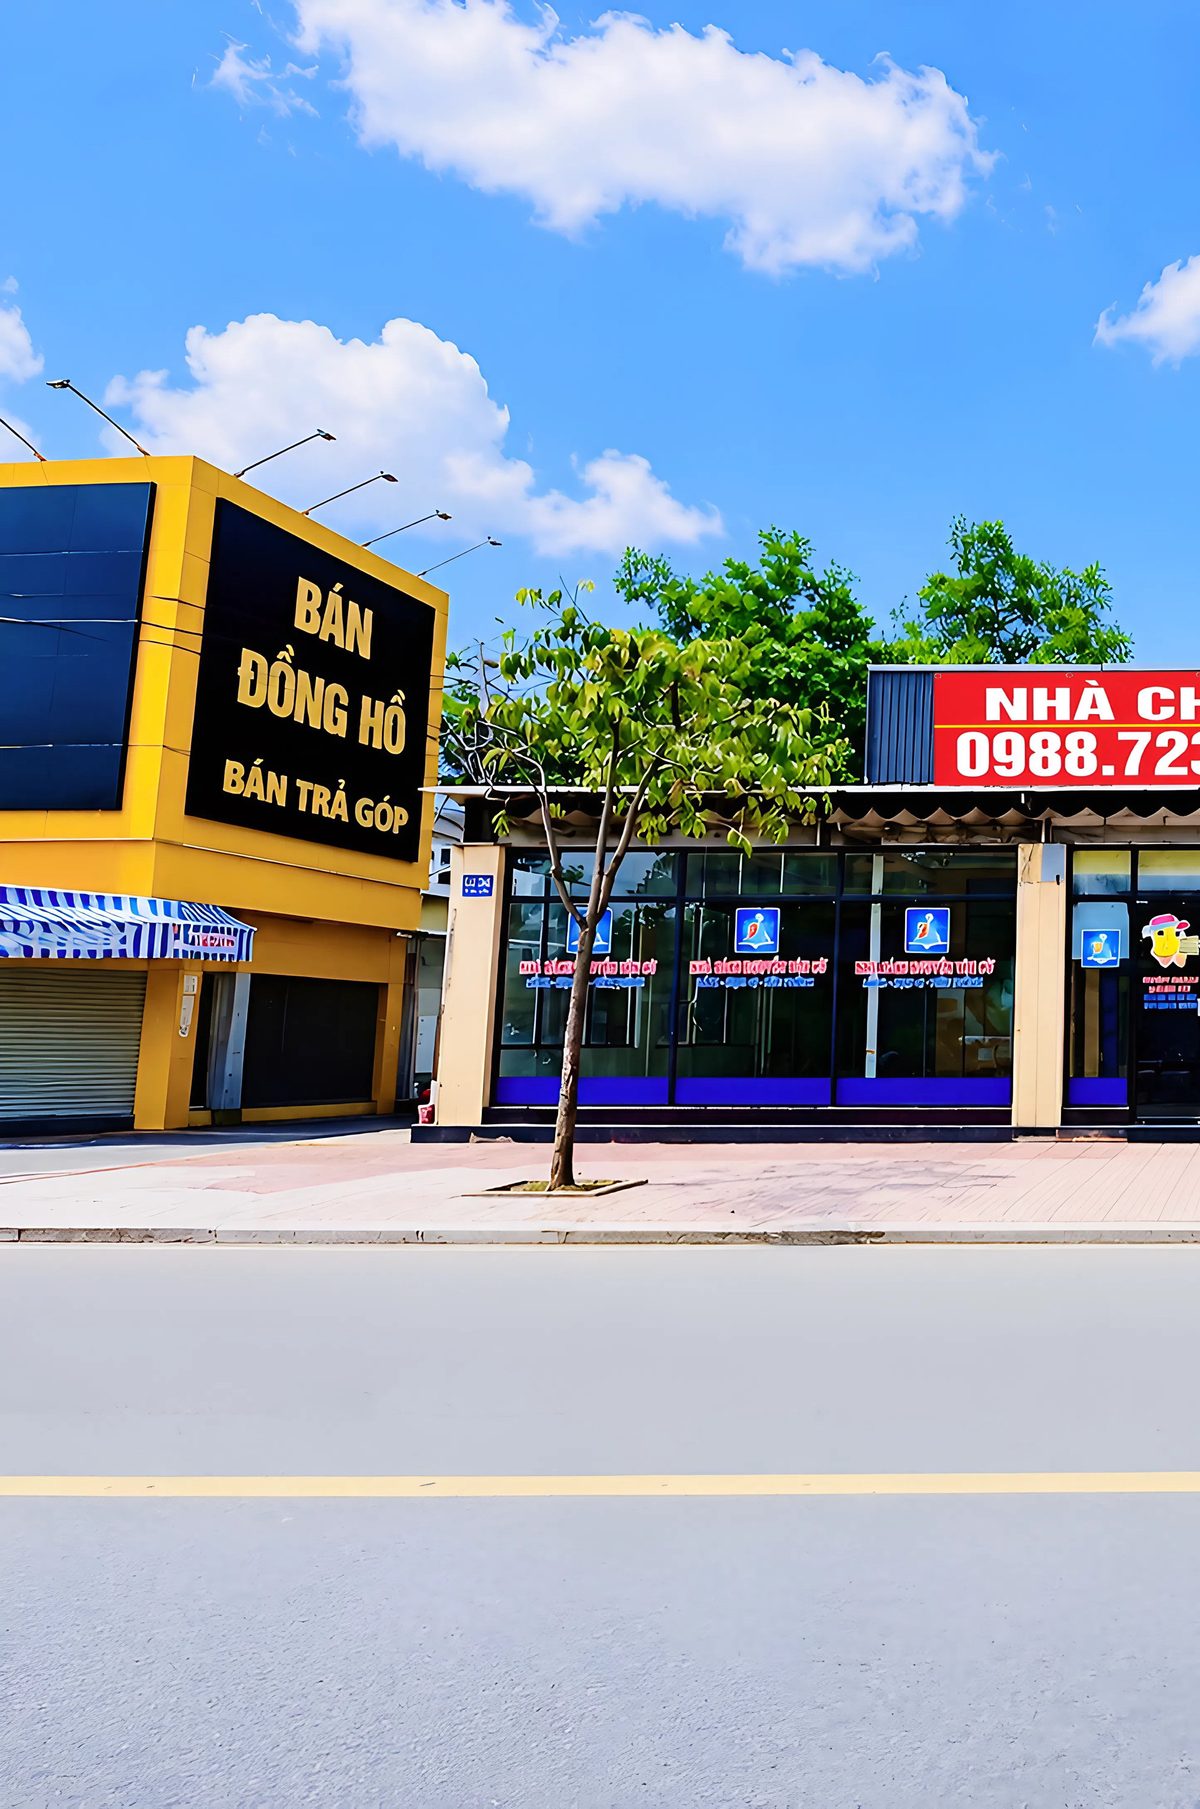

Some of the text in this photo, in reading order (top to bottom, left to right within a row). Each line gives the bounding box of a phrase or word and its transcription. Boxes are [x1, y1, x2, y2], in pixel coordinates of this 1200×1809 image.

[294, 576, 373, 660] BÁN
[237, 644, 406, 755] ĐỒNG HỒ
[985, 680, 1115, 721] NHÀ
[222, 758, 409, 834] BÁN TRẢ GÓP
